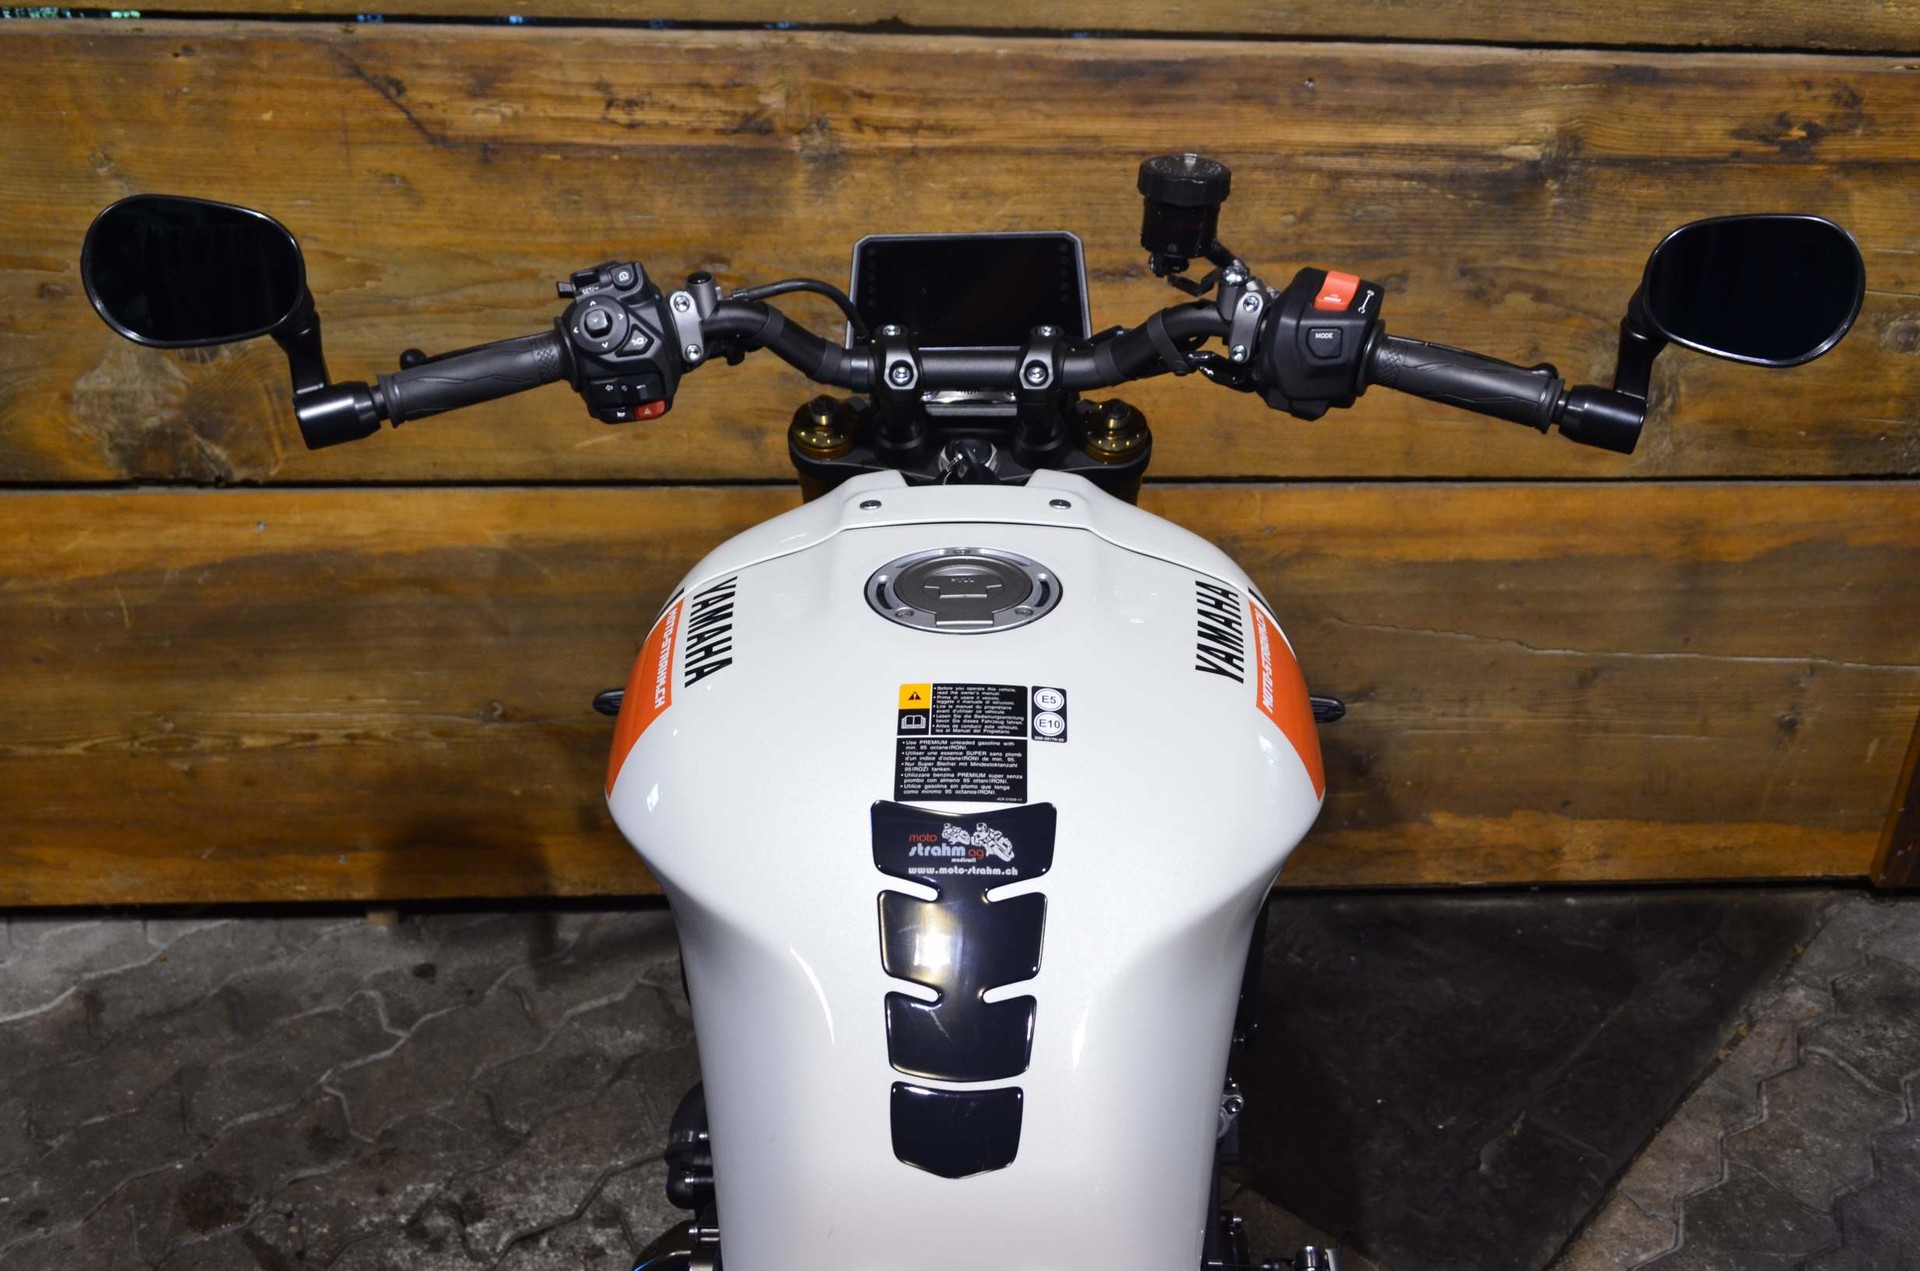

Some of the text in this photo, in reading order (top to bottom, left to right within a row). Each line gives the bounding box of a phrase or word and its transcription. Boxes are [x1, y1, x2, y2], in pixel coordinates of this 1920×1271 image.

[684, 575, 738, 689] YAMAHA
[1195, 580, 1245, 684] YAMAHA
[1042, 695, 1057, 704] E5
[1039, 719, 1060, 729] E10
[909, 833, 938, 842] moto
[908, 842, 986, 860] strahm ag
[908, 865, 1019, 876] www.moto-strahm.ch
